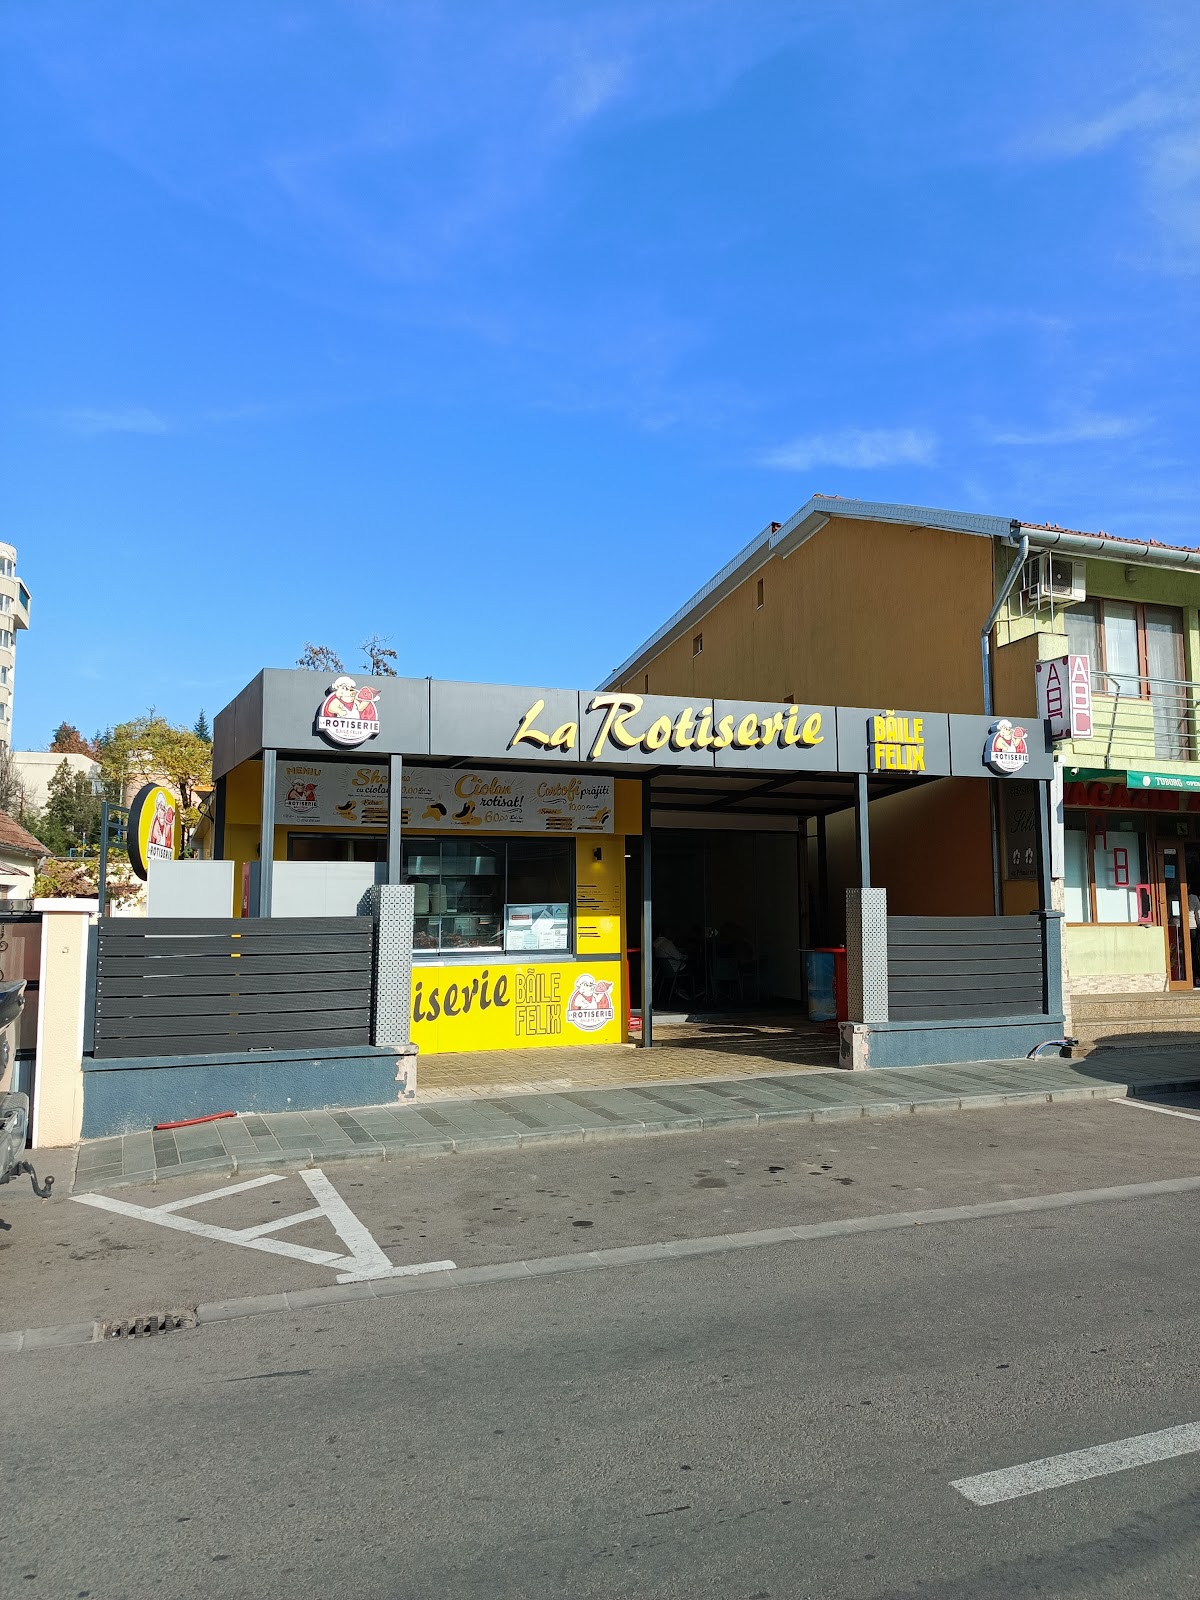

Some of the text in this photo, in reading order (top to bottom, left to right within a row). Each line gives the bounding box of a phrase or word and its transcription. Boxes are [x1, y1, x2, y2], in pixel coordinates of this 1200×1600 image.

[1072, 656, 1091, 735] ABC
[325, 719, 379, 731] ROTISERIE
[510, 694, 824, 758] La Rotiserie
[874, 743, 926, 771] FELIX
[994, 753, 1029, 762] ROTISERIE
[286, 766, 321, 777] MENIU
[454, 773, 512, 799] Ciolan
[537, 778, 581, 801] Cartofi
[480, 795, 525, 807] rotisat!
[515, 1003, 561, 1036] FELIX
[572, 1010, 612, 1019] ROTISERIE
